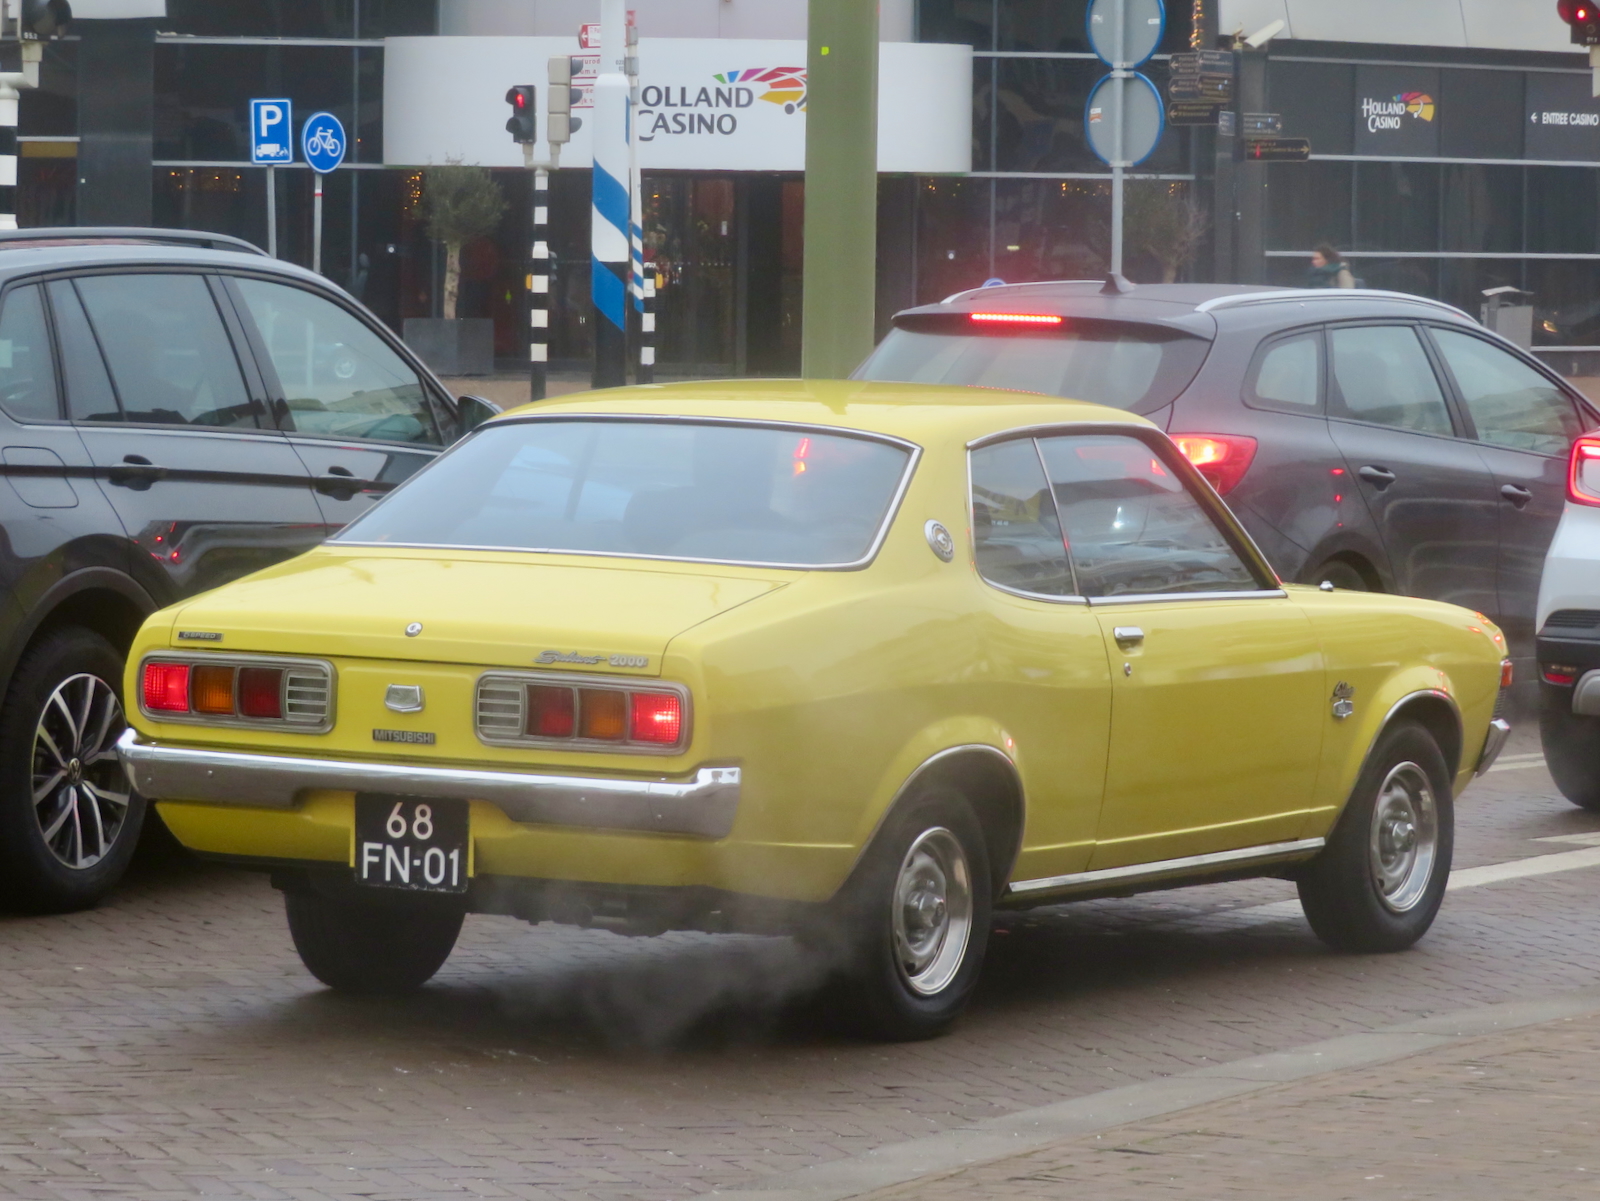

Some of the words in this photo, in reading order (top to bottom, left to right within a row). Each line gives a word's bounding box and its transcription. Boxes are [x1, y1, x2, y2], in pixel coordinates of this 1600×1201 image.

[641, 85, 754, 108] OLLAND
[1361, 97, 1406, 117] HOLLAND
[260, 105, 283, 137] P
[1367, 115, 1401, 133] CASINO
[1541, 112, 1569, 125] ENTREE
[1569, 113, 1599, 126] CASINO
[609, 654, 648, 667] 2000
[373, 729, 434, 744] MITSUBISHI
[386, 801, 434, 840] 68
[362, 841, 460, 887] FN-01
